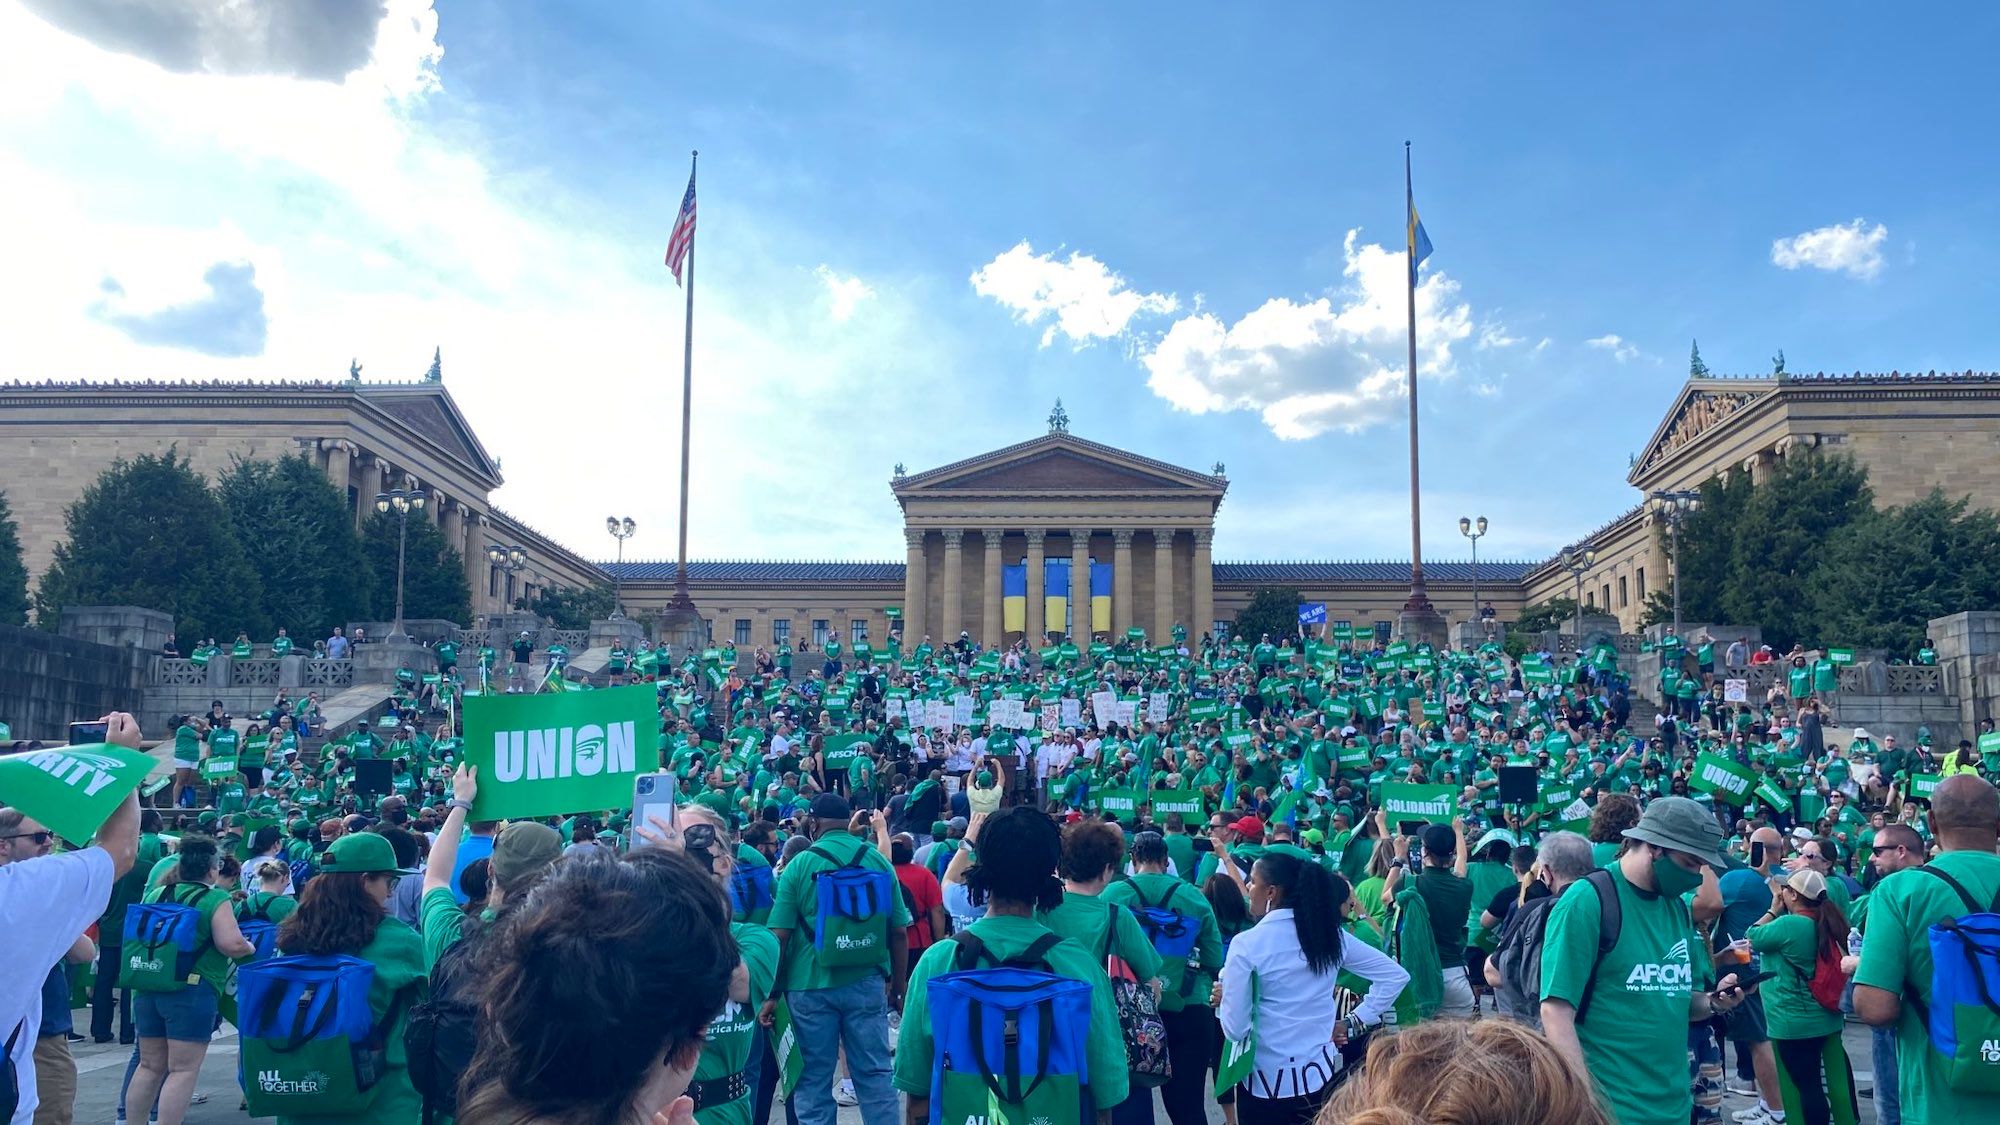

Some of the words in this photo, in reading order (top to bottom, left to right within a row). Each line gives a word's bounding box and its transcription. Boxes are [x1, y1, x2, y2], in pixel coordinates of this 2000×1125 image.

[1300, 611, 1311, 621] WE
[1311, 606, 1325, 617] ARE
[494, 720, 636, 783] UNION
[1702, 763, 1749, 796] UNION
[1103, 797, 1133, 810] UNION
[1155, 801, 1200, 813] SOLIDARITY
[1386, 799, 1450, 815] SOLIDARITY
[259, 1070, 281, 1081] ALL
[259, 1080, 318, 1092] TOGETHER
